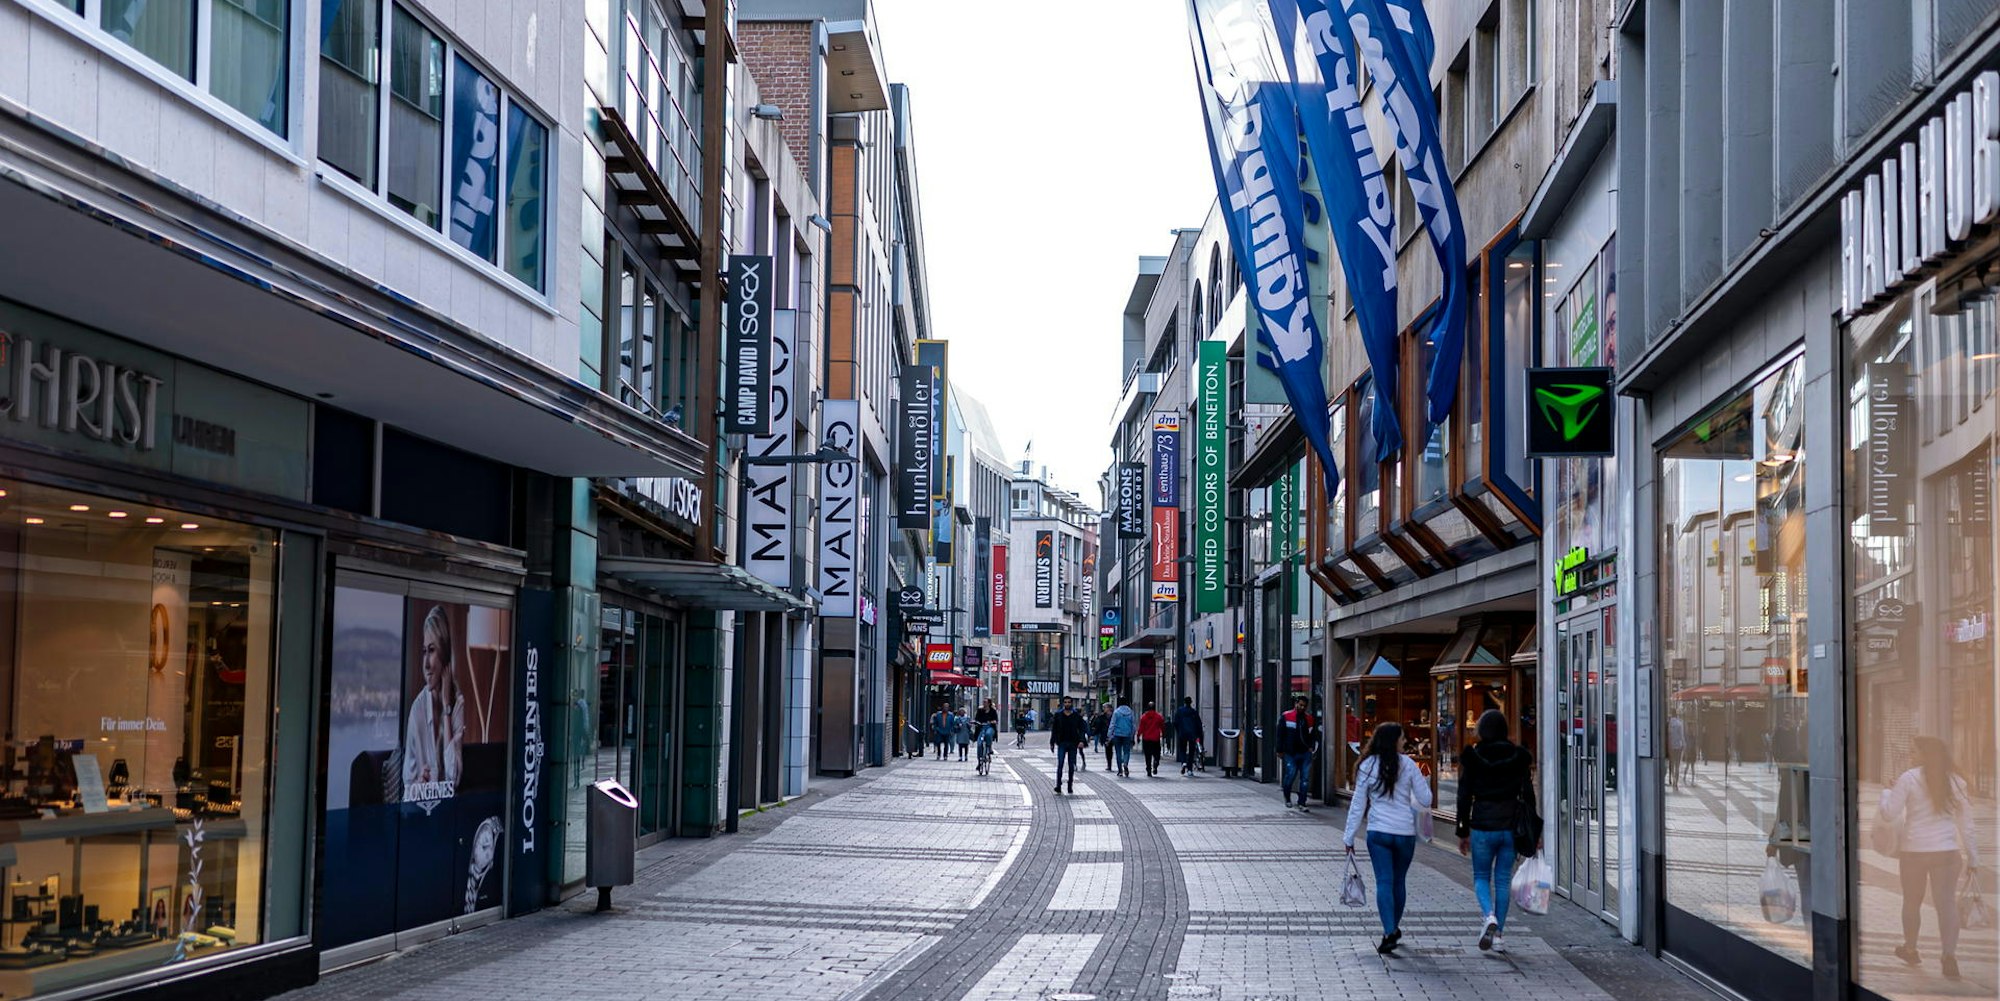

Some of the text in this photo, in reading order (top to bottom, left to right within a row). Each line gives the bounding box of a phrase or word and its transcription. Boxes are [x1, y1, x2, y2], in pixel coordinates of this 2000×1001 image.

[739, 347, 758, 385] DAVID
[738, 387, 757, 425] CAMP
[1158, 414, 1176, 424] dm
[906, 379, 928, 515] hunkemöller
[1157, 434, 1173, 452] 73
[1204, 361, 1218, 591] UNITED COLORS OF BENETTON.
[823, 421, 854, 597] MANGO
[1121, 468, 1133, 532] MAISONS
[1135, 519, 1142, 533] DU
[995, 573, 1003, 607] UNIQLO
[1037, 558, 1051, 604] SATURN
[1157, 584, 1175, 594] dm
[906, 622, 928, 632] VANS
[929, 652, 951, 661] LEGO
[1027, 681, 1060, 693] SATURN
[101, 717, 116, 731] Für
[118, 718, 145, 731] immer
[523, 647, 539, 854] LONGINES
[403, 780, 455, 802] LONGINES
